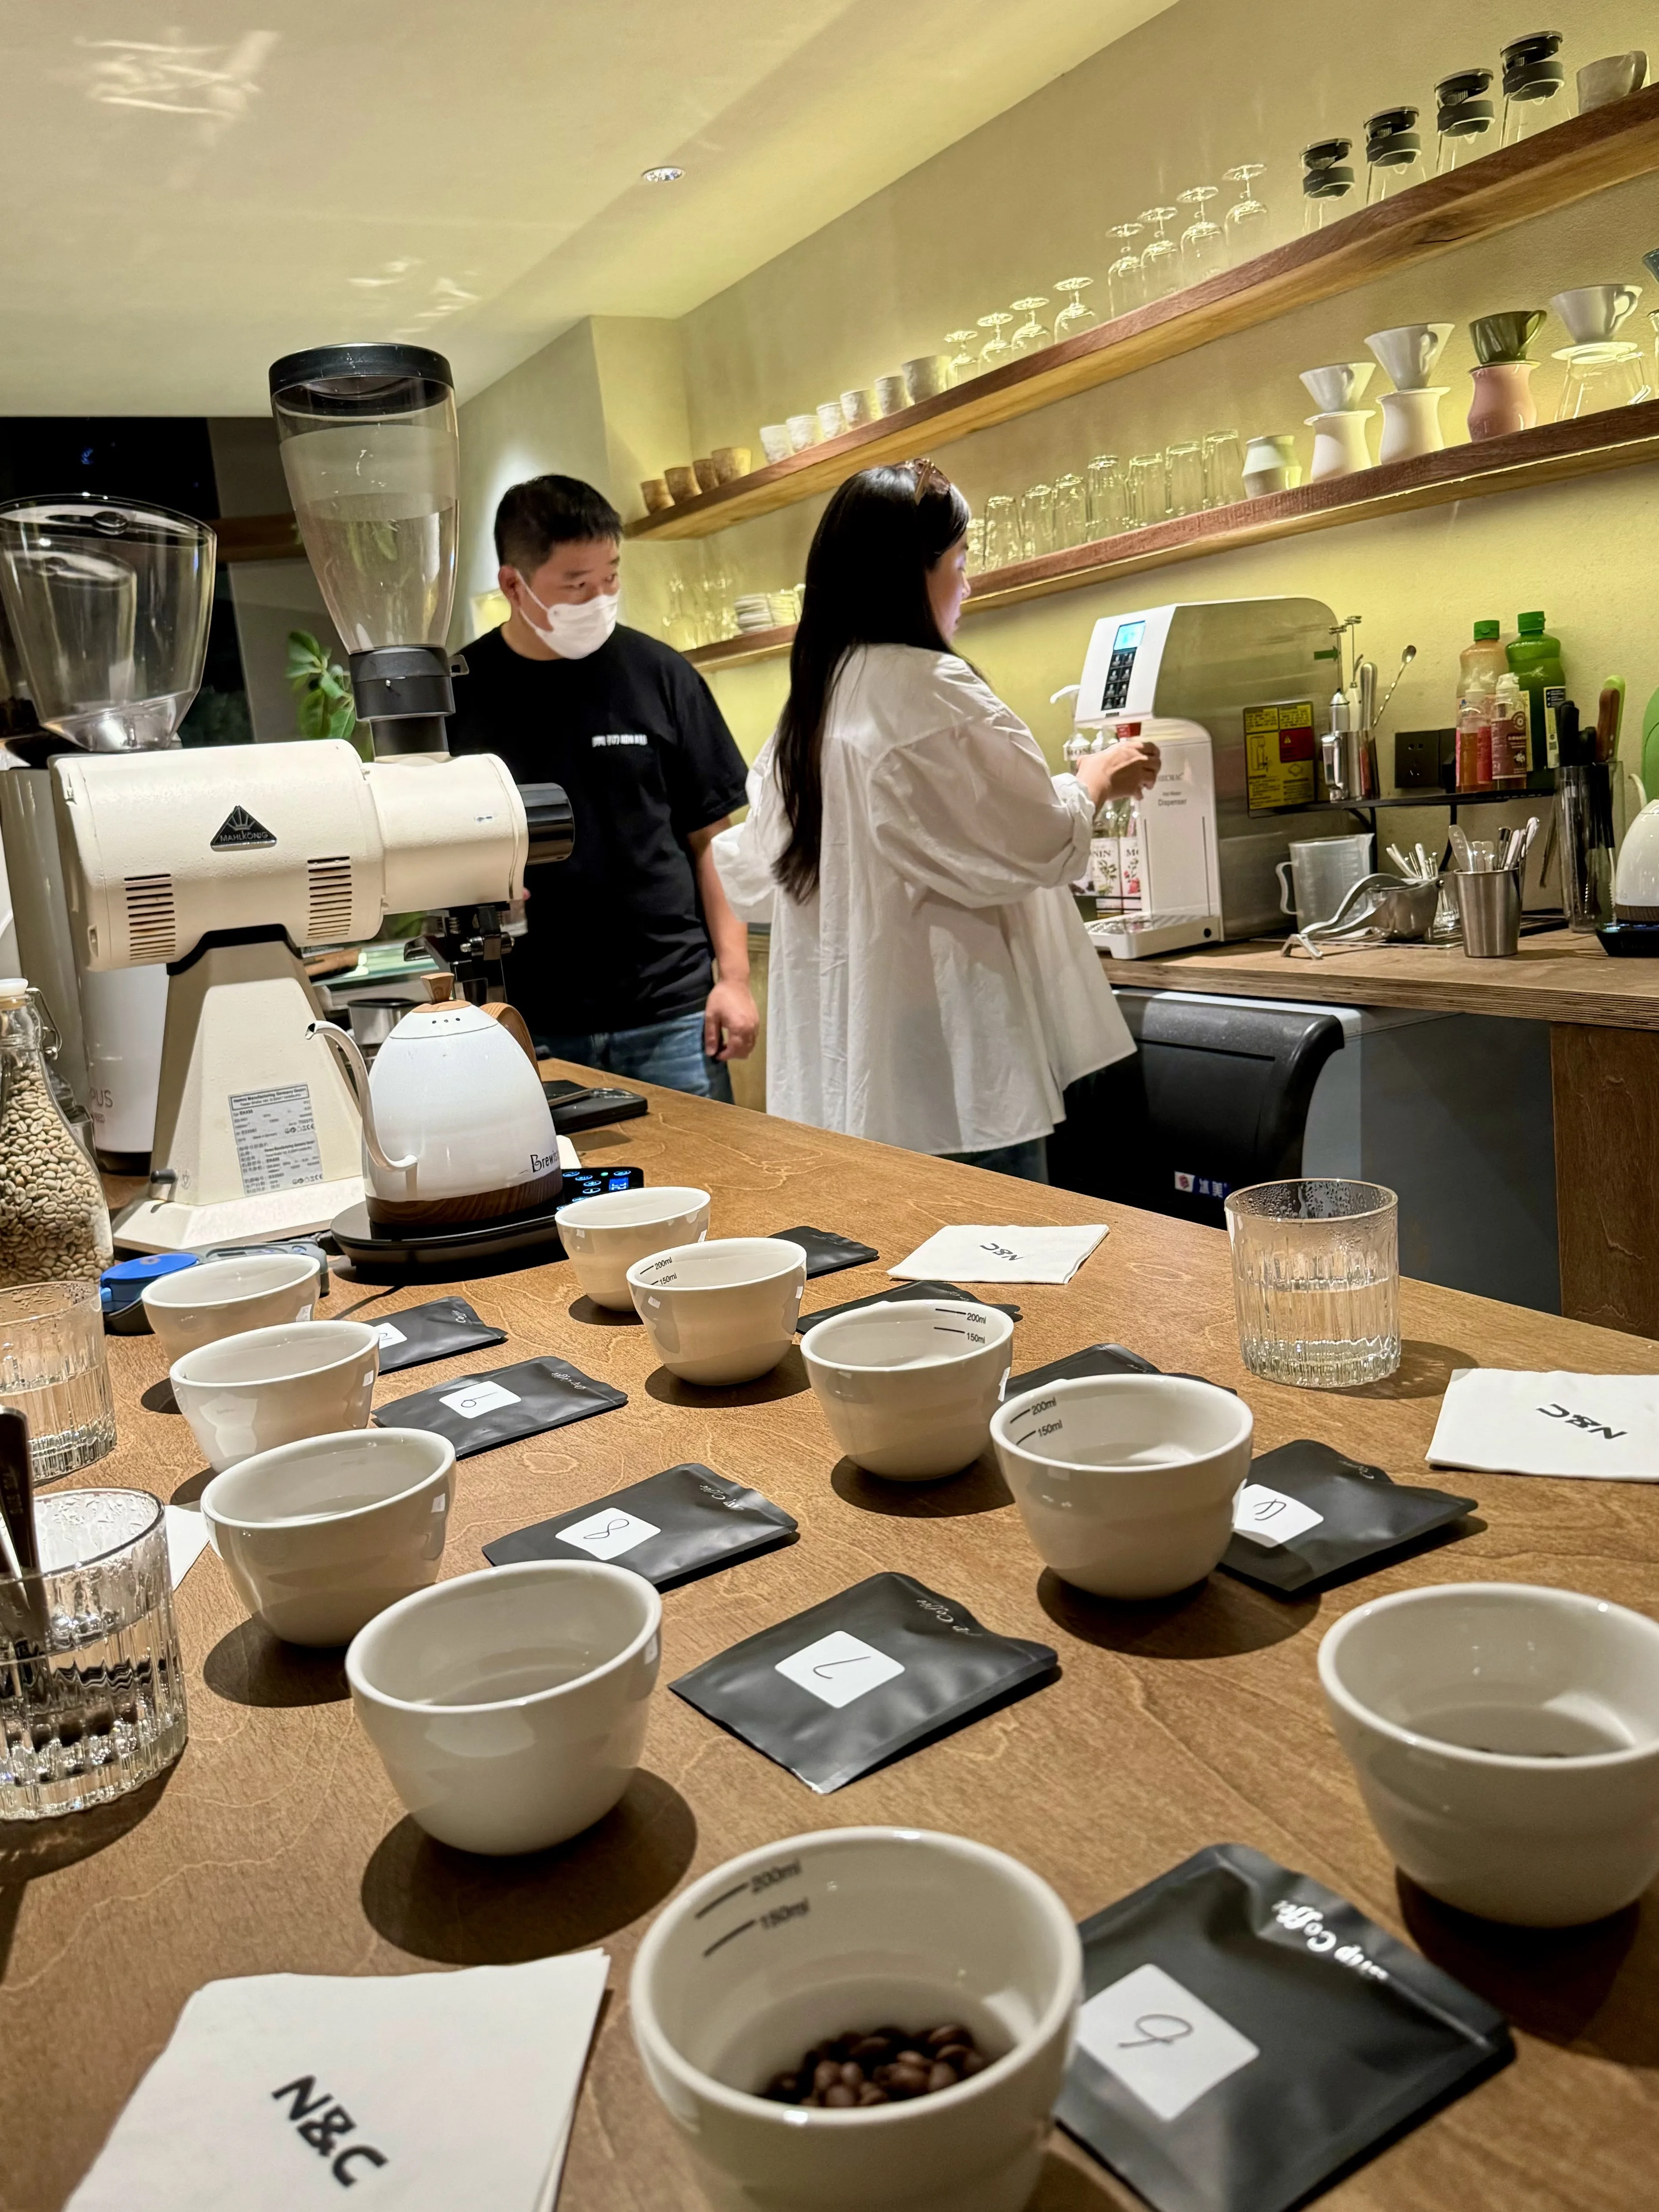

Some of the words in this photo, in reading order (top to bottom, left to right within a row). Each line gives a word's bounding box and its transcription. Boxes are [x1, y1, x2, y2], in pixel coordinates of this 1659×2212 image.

[655, 1257, 672, 1270] 200ml
[659, 1273, 677, 1285] 150ml
[967, 1313, 987, 1324] 200ml
[967, 1333, 986, 1344] 150ml
[1031, 1396, 1056, 1416] 200ml
[1037, 1419, 1063, 1437] 150ml
[583, 1518, 629, 1539] 8
[751, 1859, 802, 1893] 200ml
[759, 1897, 810, 1929] 150ml
[271, 2074, 389, 2188] N&C
